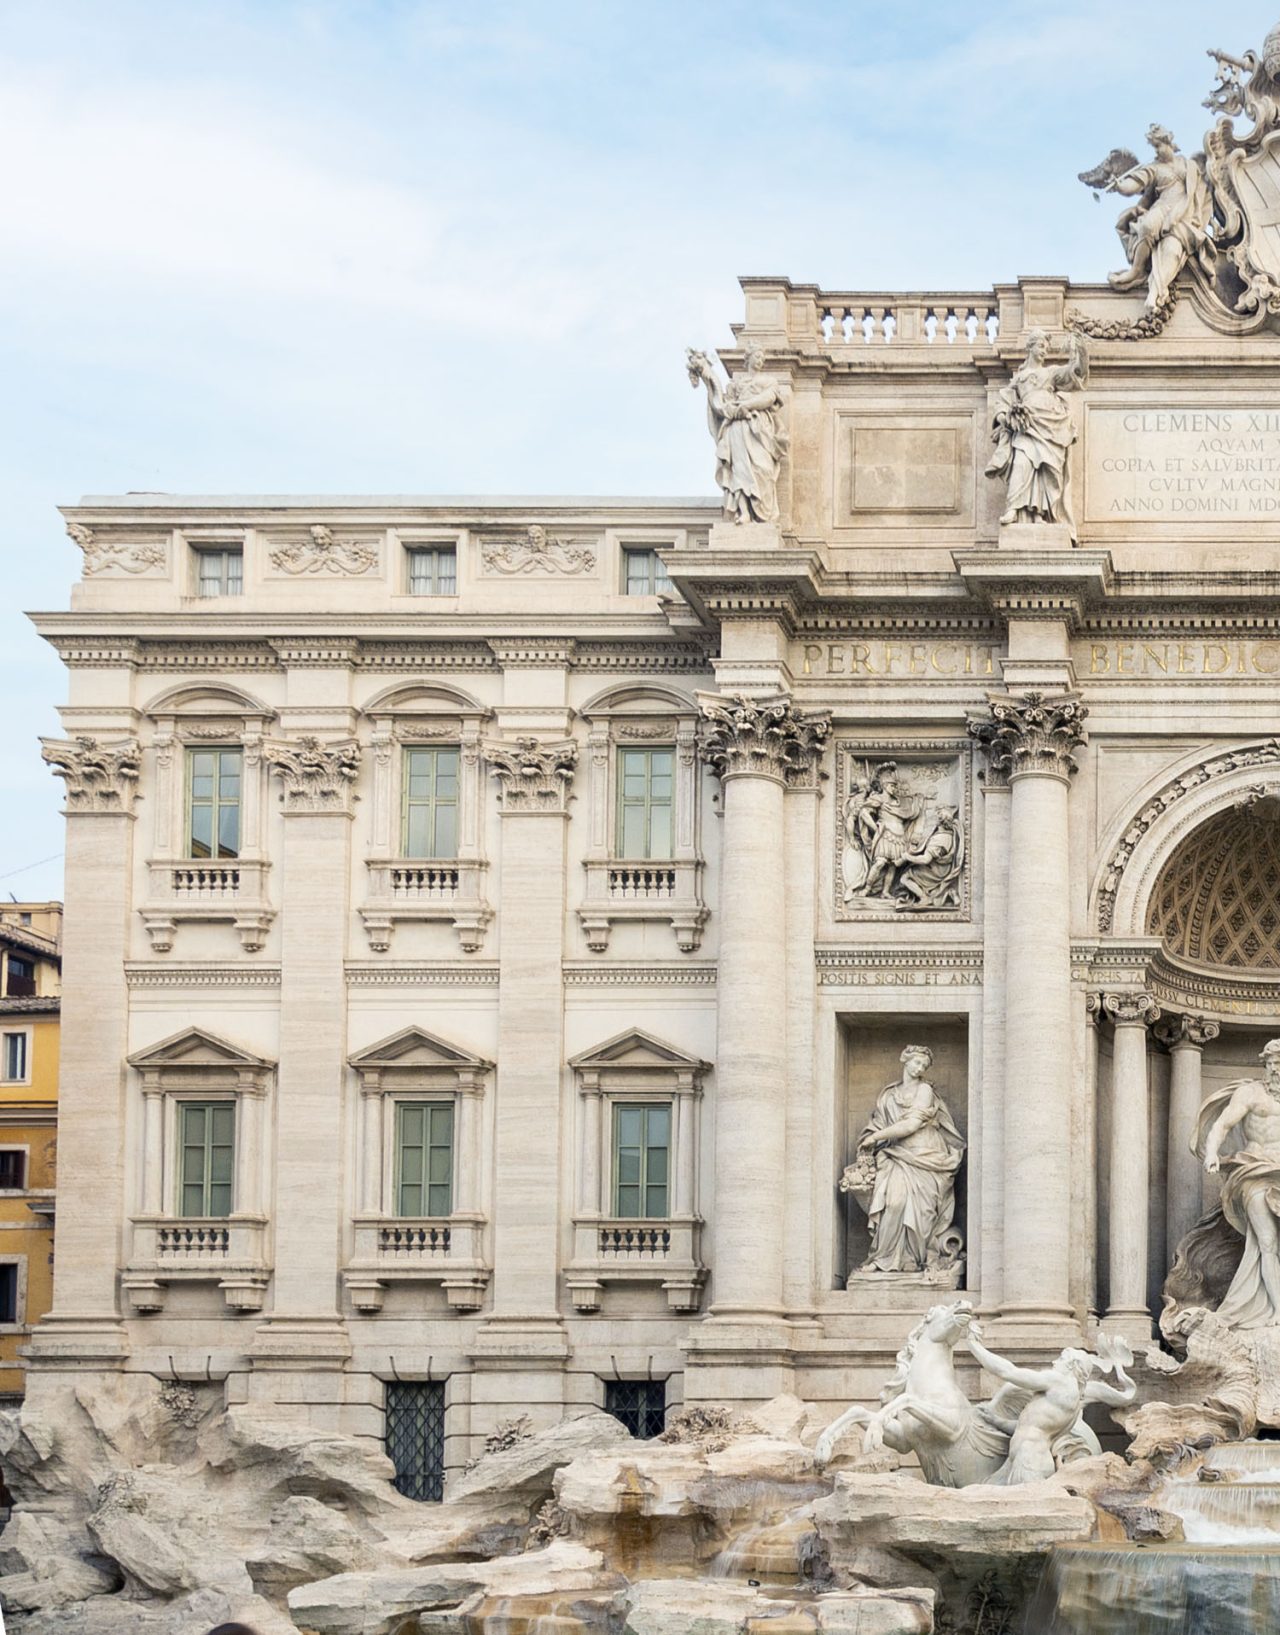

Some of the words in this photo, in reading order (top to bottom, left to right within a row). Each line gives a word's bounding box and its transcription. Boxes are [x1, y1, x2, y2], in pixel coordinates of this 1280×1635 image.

[1122, 413, 1233, 433] CLEMENS
[1196, 437, 1265, 456] AQVAM
[1102, 457, 1155, 473] COPIA
[1164, 457, 1185, 473] ET
[1149, 477, 1209, 493] CVLTV
[1109, 497, 1165, 513] ANNO
[1171, 497, 1239, 513] DOMINI
[802, 643, 1002, 675] PERFECIT
[820, 973, 868, 985] POSITIS
[875, 973, 916, 985] SIGNIS
[925, 973, 940, 985] ET
